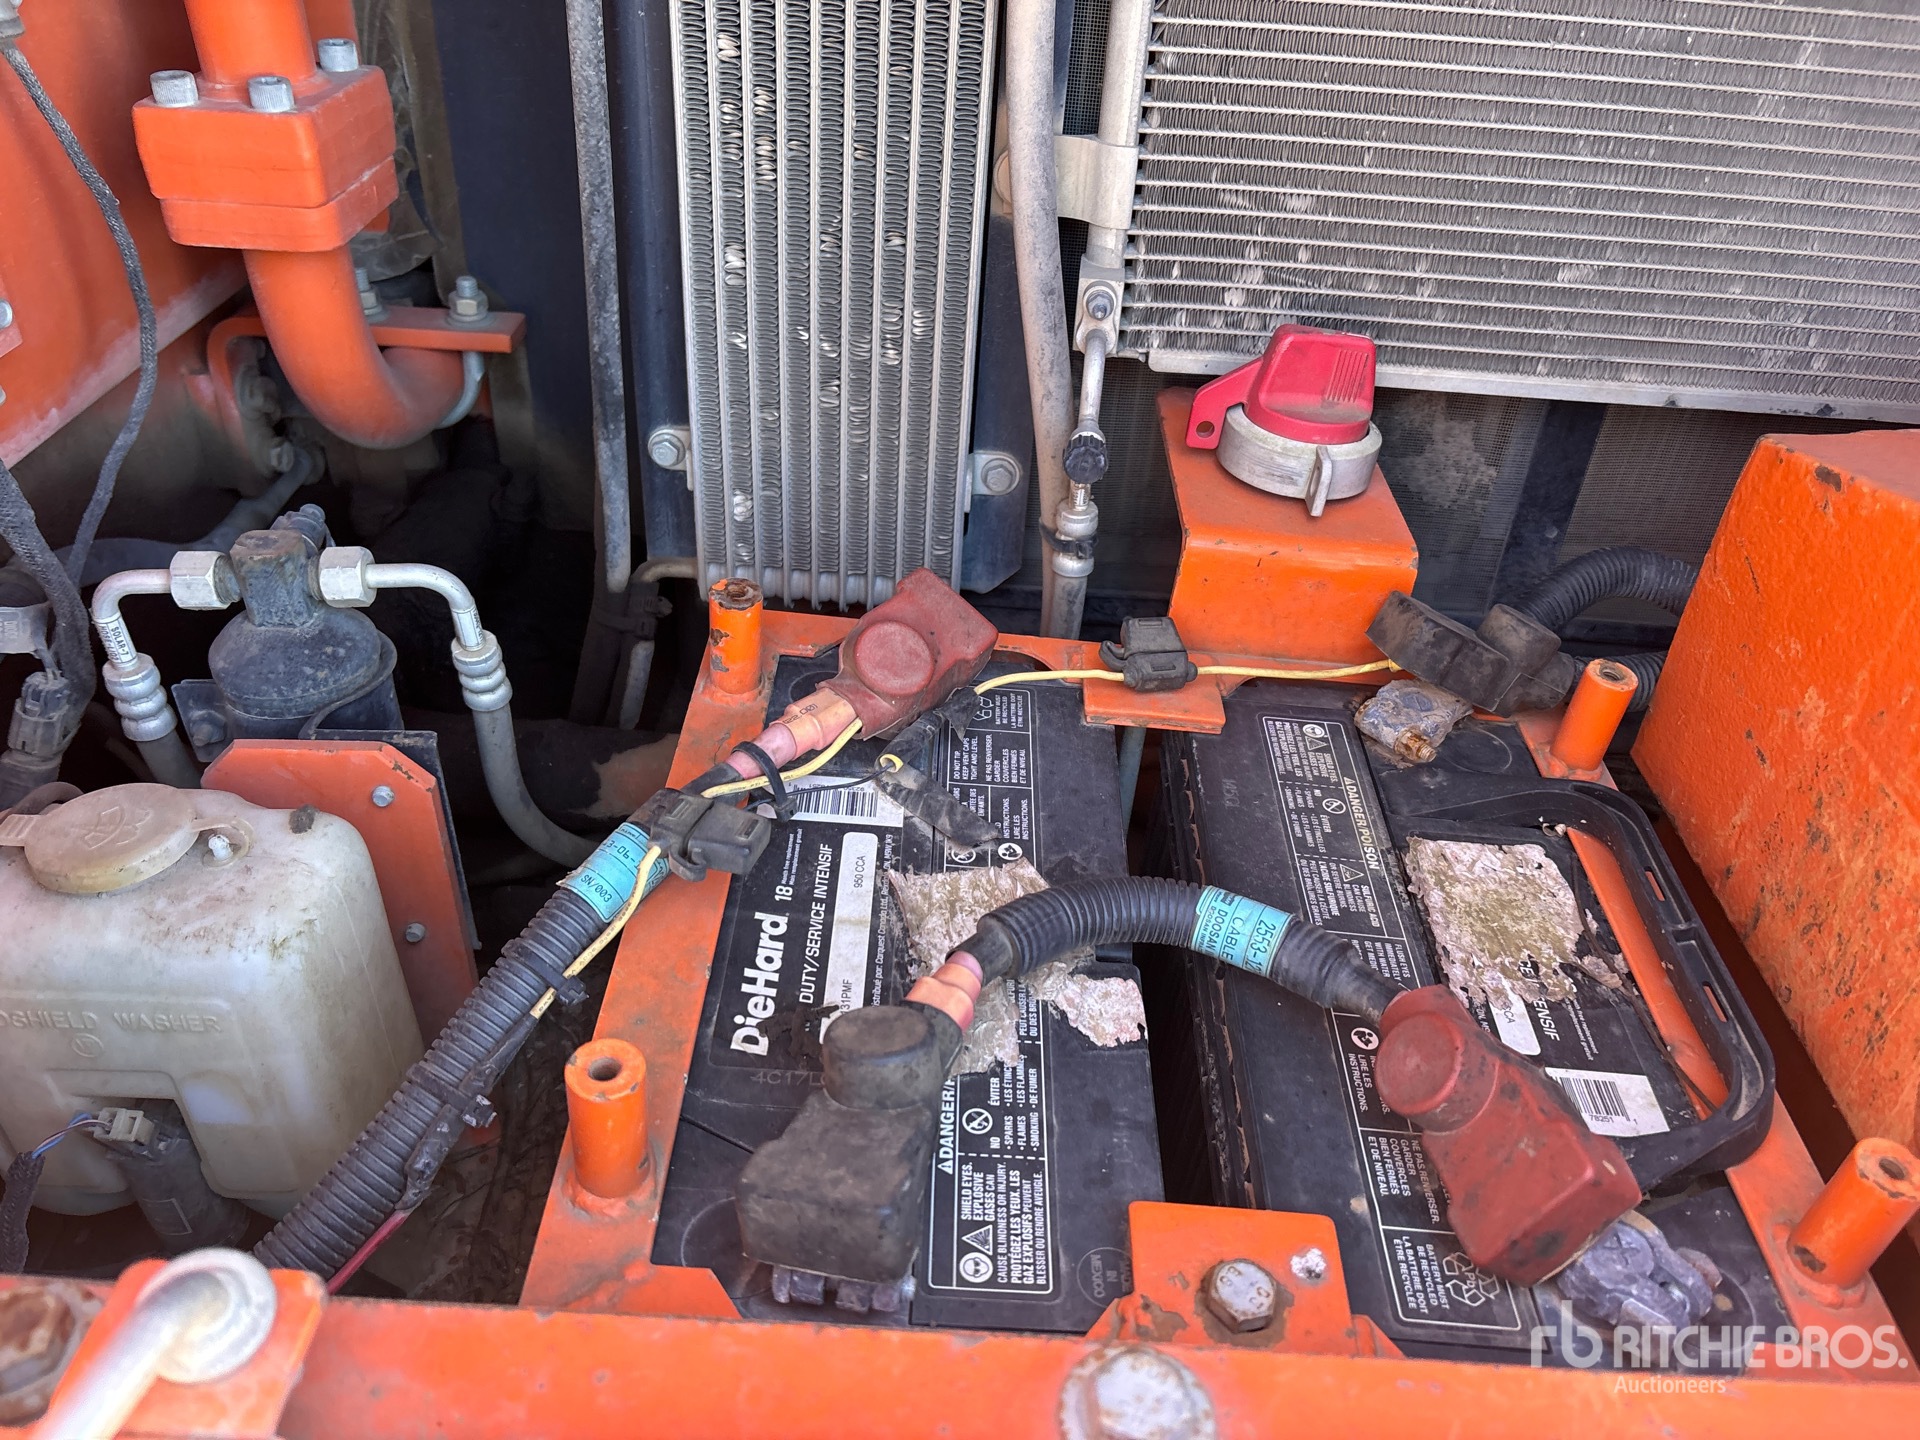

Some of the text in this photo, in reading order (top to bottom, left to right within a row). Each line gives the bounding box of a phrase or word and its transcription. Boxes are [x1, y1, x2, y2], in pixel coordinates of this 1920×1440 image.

[1346, 786, 1380, 870] DANGER/POISON
[580, 874, 613, 903] SN/003
[814, 843, 833, 898] INTENSIF
[853, 856, 866, 888] 950 CCA
[774, 885, 794, 902] 18
[1361, 885, 1380, 928] SULFURIC ACID
[875, 937, 885, 964] Carquest
[1206, 909, 1228, 951] DOOSAN
[1221, 916, 1244, 960] CABLE
[1364, 941, 1374, 952] GET
[799, 902, 825, 1004] DUTY/SERVICE
[1375, 942, 1390, 978] WITH WATER
[1395, 944, 1410, 978] FLUSH EYES
[730, 912, 788, 1056] DieHard
[113, 1011, 222, 1032] WASHER
[1019, 1020, 1027, 1036] PEUT
[1029, 1013, 1037, 1026] DES
[1030, 1026, 1038, 1036] OU
[1348, 1053, 1368, 1112] INSTRUCTIONS.
[1358, 1054, 1372, 1088] LIRE LES
[988, 1077, 1000, 1149] NO ÉVITER
[1004, 1088, 1013, 1102] LES
[1017, 1089, 1025, 1103] LES
[1029, 1068, 1040, 1147] SMOKING DE FUMER
[1004, 1116, 1014, 1145] SPARKS
[1017, 1116, 1026, 1146] FLAMES
[1589, 1114, 1614, 1123] 78251
[1368, 1136, 1388, 1196] ET DE NIVEAU.
[1379, 1137, 1389, 1159] BIEN
[1389, 1138, 1411, 1197] COUVERCLES
[1400, 1139, 1416, 1176] GARDER
[961, 1162, 972, 1220] SHIELD EYES.
[973, 1172, 984, 1220] EXPLOSIVE
[985, 1174, 995, 1221] GASES CAN
[1411, 1139, 1440, 1224] NE PAS RENVERSER.
[997, 1162, 1007, 1283] CAUSE BLINDNESS OR INJURY.
[1008, 1170, 1022, 1283] PROTÉGEZ LES YEUX. LES
[1022, 1180, 1034, 1284] GAZ EXPLOSIFS PEUVENT
[1034, 1171, 1046, 1284] BLESSER OU RENDRE AVEUGLE.
[1090, 1254, 1105, 1298] MEXICO
[1394, 1238, 1417, 1310] ÊTRE RECYCLÉE
[1402, 1236, 1428, 1314] LA BATTERIE DOIT
[1417, 1246, 1438, 1306] BE RECYCLED
[1426, 1244, 1450, 1310] BATTERY MUST
[1464, 1272, 1476, 1289] Pb
